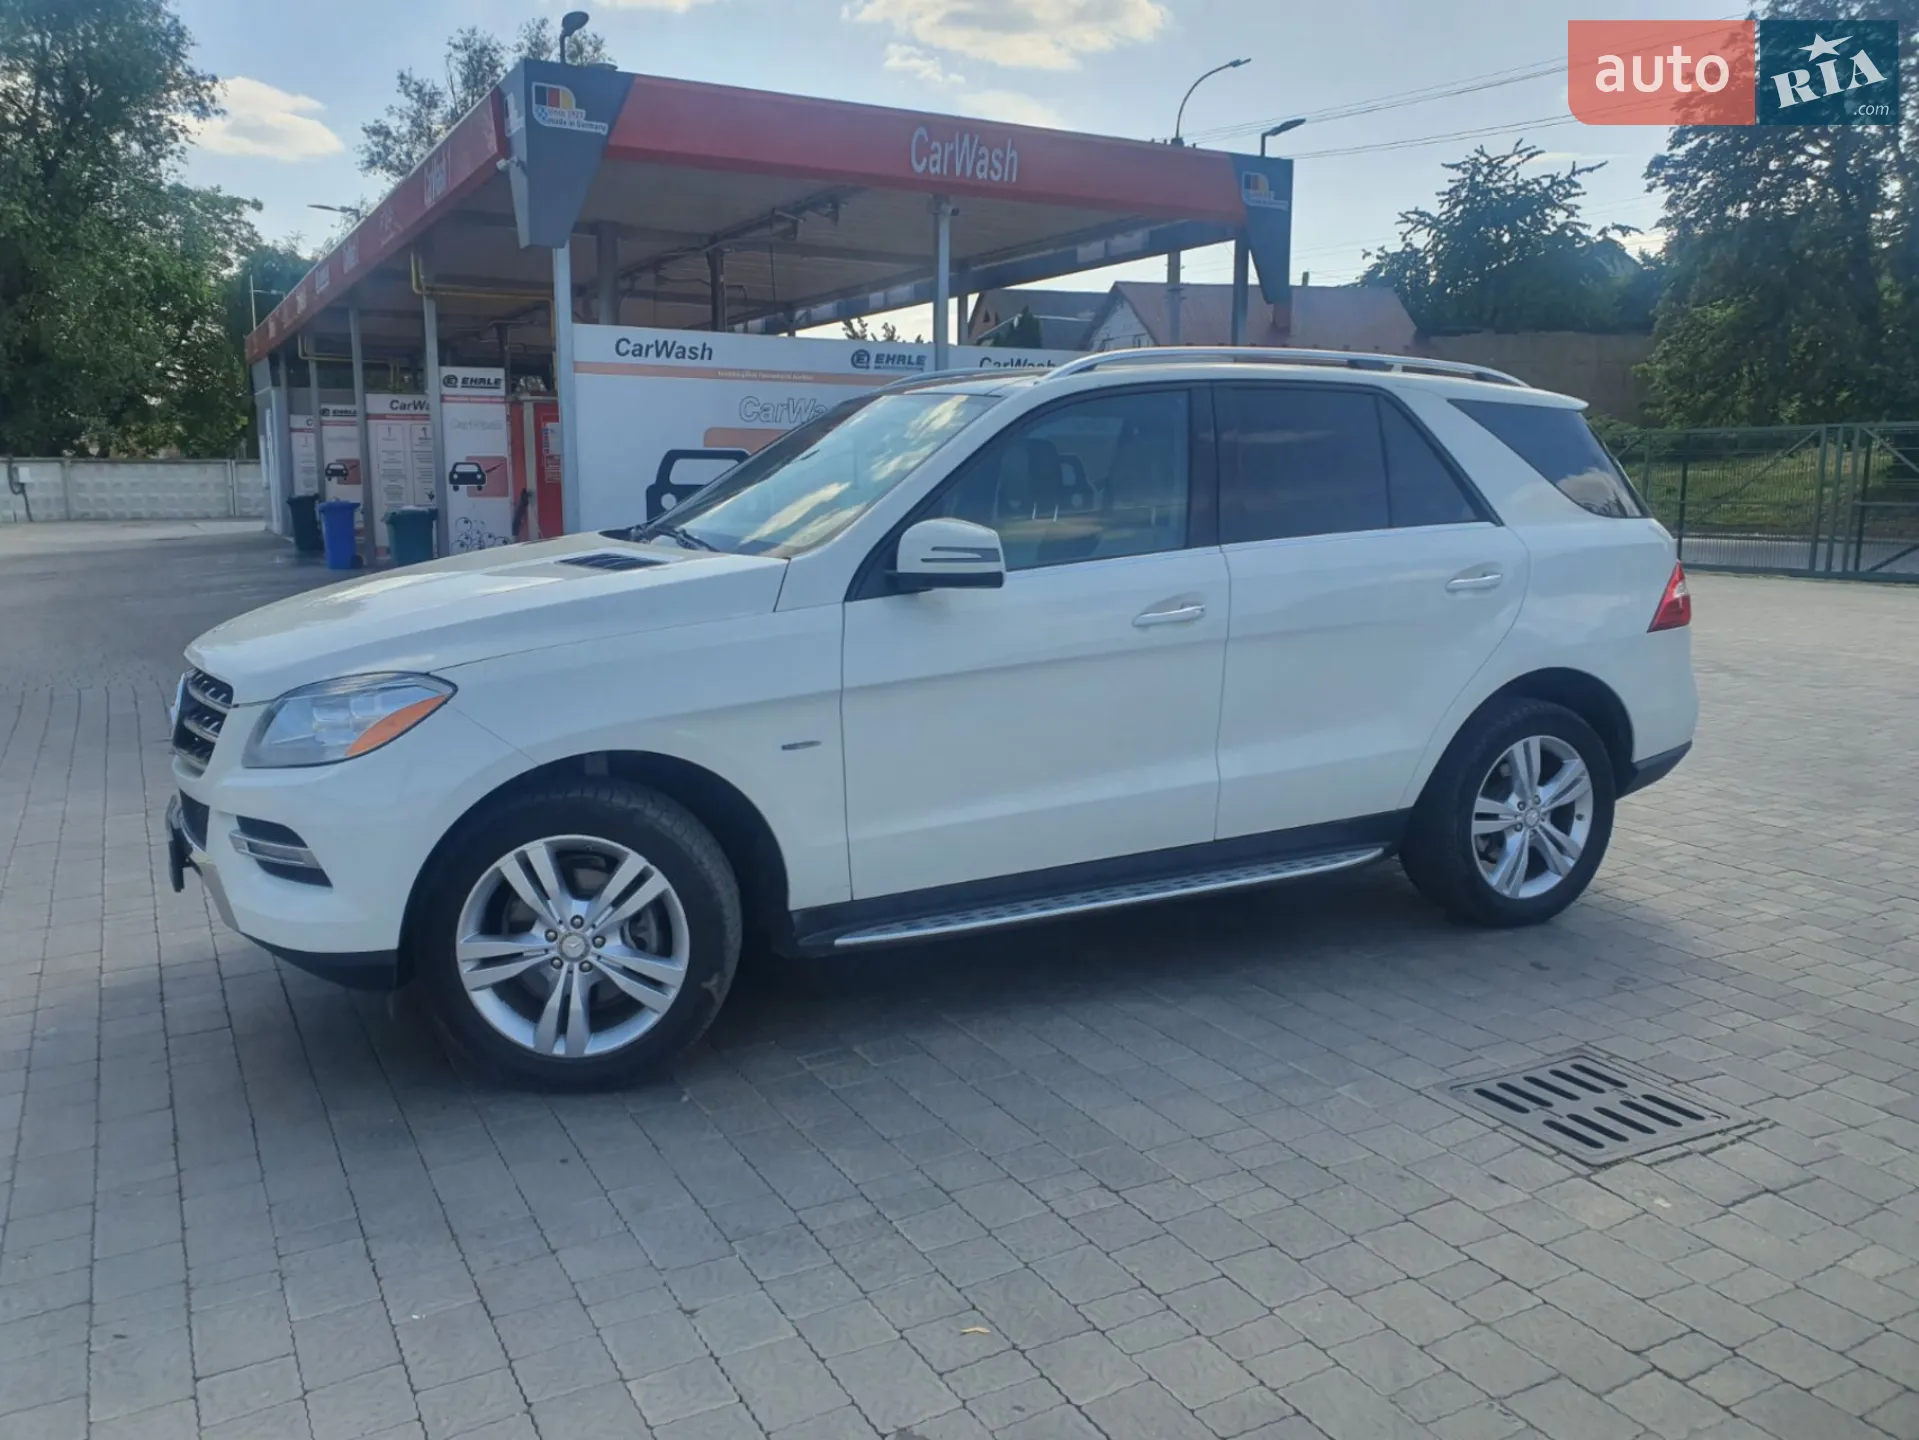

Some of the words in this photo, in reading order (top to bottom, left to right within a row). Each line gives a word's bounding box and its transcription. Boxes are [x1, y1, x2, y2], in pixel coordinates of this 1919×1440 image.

[910, 126, 1018, 183] CarWash
[614, 337, 714, 361] CarWash
[874, 353, 927, 367] EHRLE
